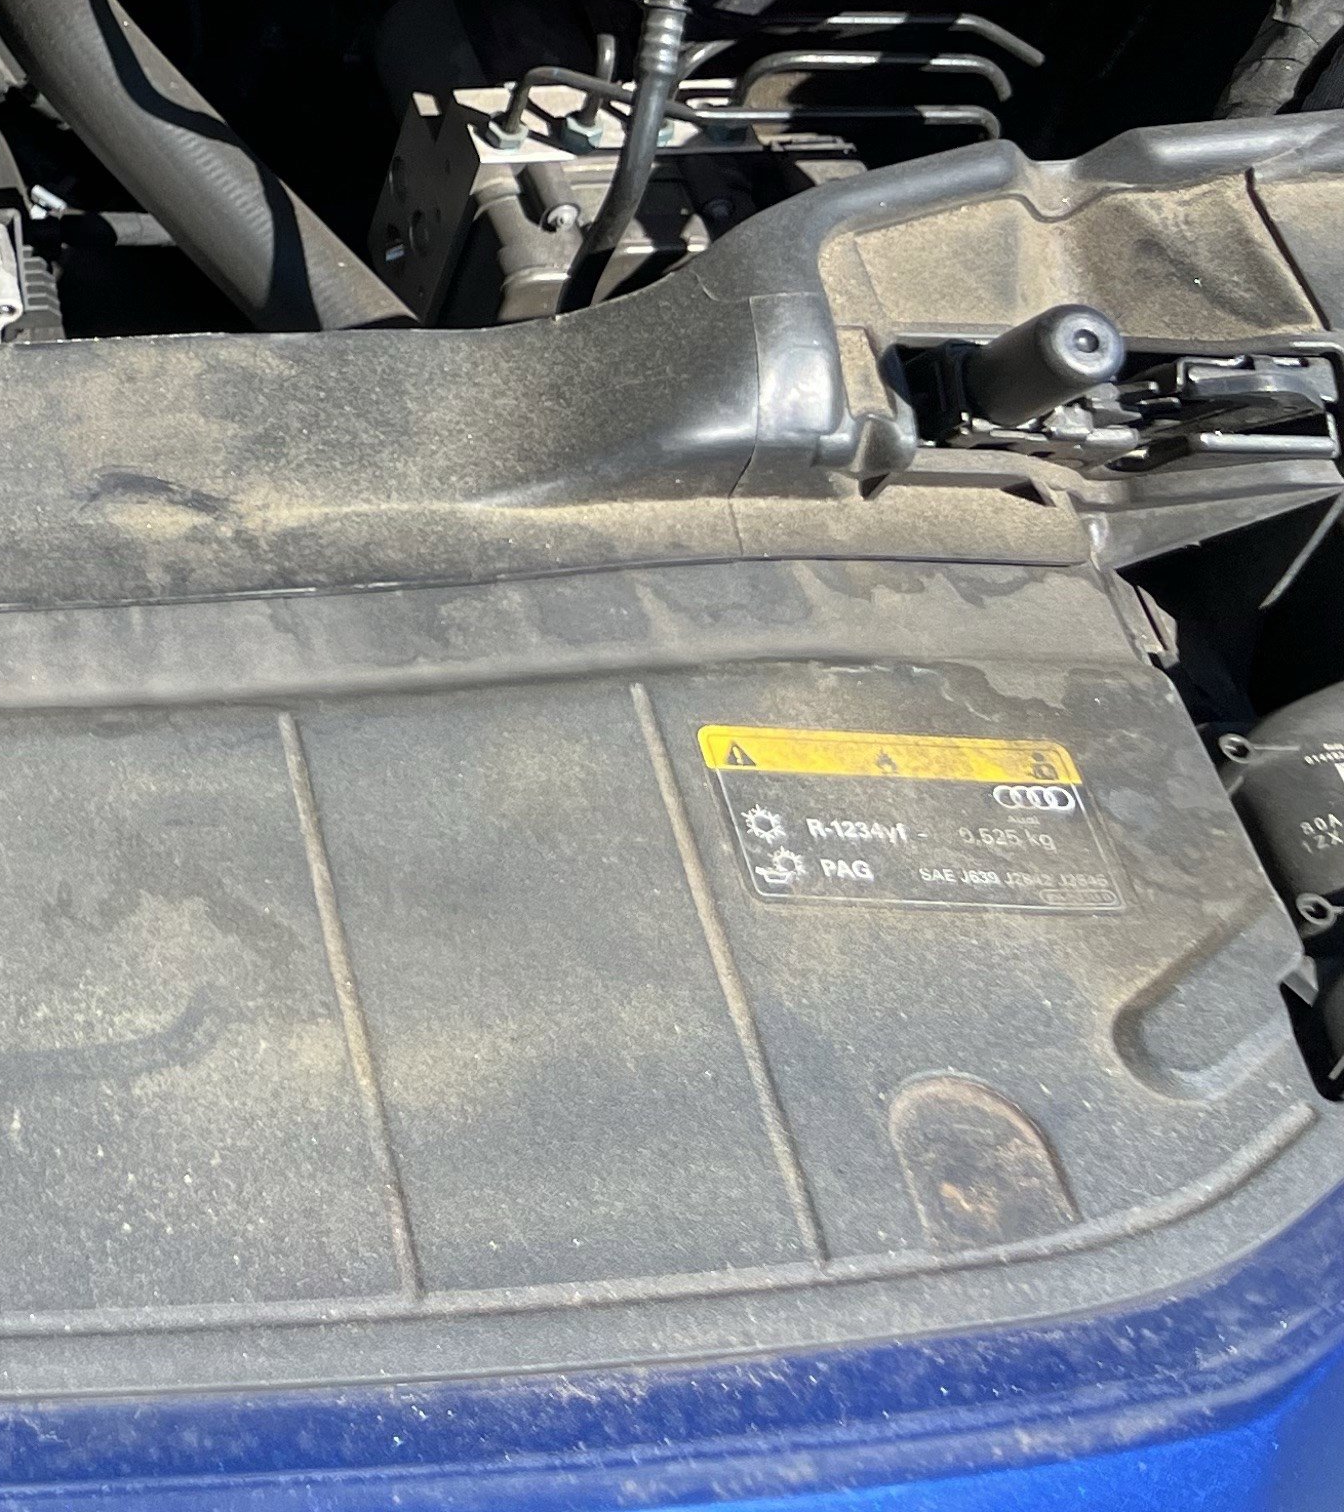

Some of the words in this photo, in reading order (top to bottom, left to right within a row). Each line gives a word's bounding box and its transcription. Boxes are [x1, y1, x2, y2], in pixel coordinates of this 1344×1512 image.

[805, 817, 911, 843] R-1234yf
[1025, 828, 1057, 855] kg
[820, 858, 875, 882] PAG
[919, 866, 956, 884] SAE
[959, 869, 1000, 887] J639
